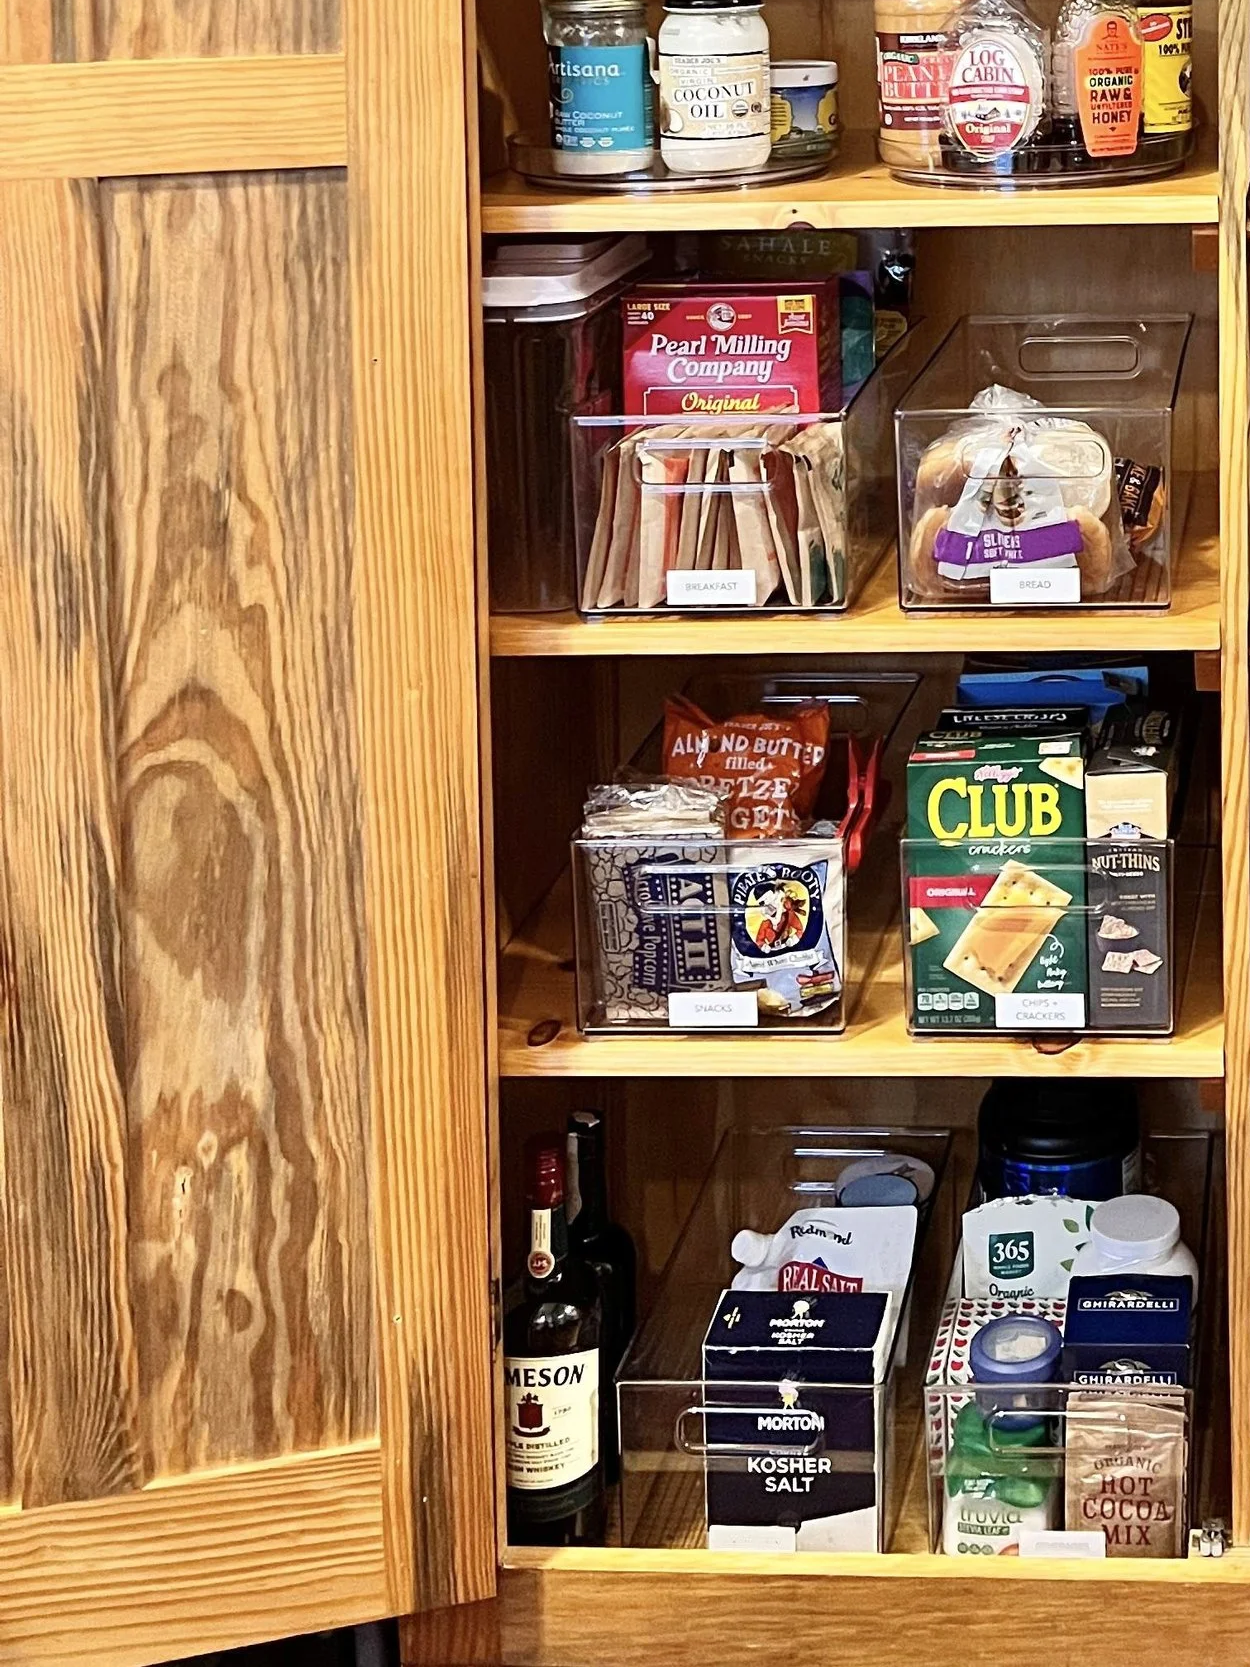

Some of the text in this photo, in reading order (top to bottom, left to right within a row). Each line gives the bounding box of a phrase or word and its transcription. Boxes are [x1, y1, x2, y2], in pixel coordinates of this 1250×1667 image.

[1096, 43, 1128, 51] NATE'S
[674, 57, 699, 65] TRADER
[969, 49, 1006, 66] LOG
[961, 66, 1015, 84] CABIN
[1088, 66, 1133, 75] 100% PURE
[680, 78, 714, 86] VIRGIN
[1089, 75, 1133, 88] ORGANIC
[673, 82, 754, 103] COCONUT
[1090, 88, 1133, 103] RAW &
[690, 104, 725, 119] OIL
[1092, 110, 1132, 124] HONEY
[965, 123, 1011, 136] Original
[719, 235, 832, 256] SAHALE
[743, 253, 808, 265] SNACKS
[627, 302, 671, 311] LARGE SIZE
[641, 312, 654, 321] 40
[650, 333, 792, 361] Pearl Milling
[667, 358, 774, 384] Company
[681, 392, 761, 415] Original
[684, 581, 738, 592] BREAKFAST
[1019, 580, 1052, 589] BREAD
[724, 756, 765, 770] filled
[927, 776, 1063, 842] CLUB
[968, 840, 1032, 857] crackers
[1092, 852, 1161, 873] NUT-THINS
[733, 865, 820, 906] PIRATE'S BOOTY
[641, 934, 662, 987] Popcorn
[694, 1004, 733, 1013] SNACKS
[1022, 999, 1049, 1008] CHIPS
[1015, 1012, 1066, 1021] CRACKERS
[992, 1239, 1030, 1264] 365
[783, 1265, 858, 1293] REAL SALT
[989, 1283, 1035, 1301] Organic
[1082, 1300, 1175, 1310] GHIRARDELLI
[768, 1318, 825, 1328] MORTON
[1078, 1375, 1172, 1385] GHIRARDELLI
[757, 1416, 825, 1431] MORTON
[525, 1437, 571, 1450] DISTILLED
[526, 1462, 565, 1473] WHISKEY
[746, 1456, 832, 1475] KOSHER
[1093, 1456, 1163, 1475] ORGANIC
[764, 1477, 815, 1493] SALT
[1100, 1475, 1154, 1497] HOT
[960, 1509, 1023, 1524] truvia
[1082, 1497, 1171, 1522] COCOA
[1101, 1523, 1153, 1546] MIX
